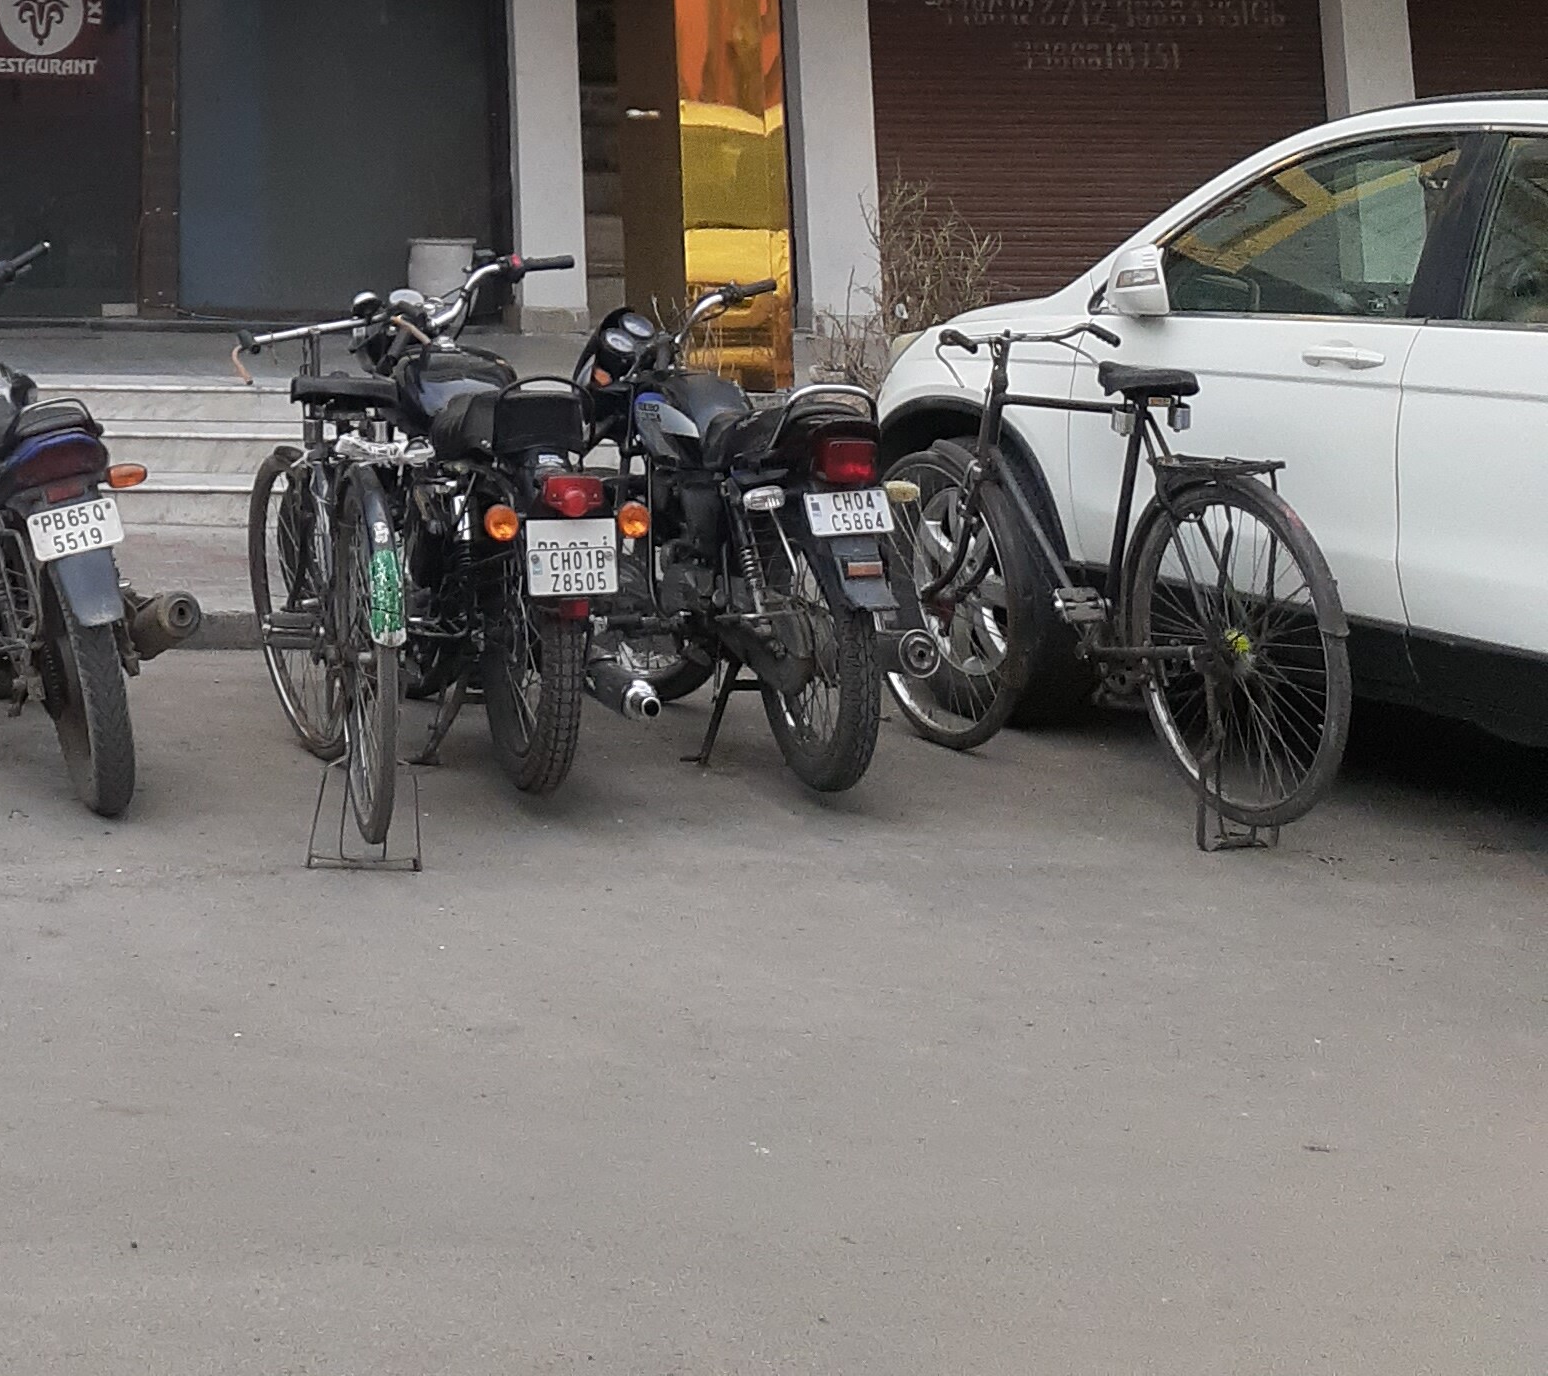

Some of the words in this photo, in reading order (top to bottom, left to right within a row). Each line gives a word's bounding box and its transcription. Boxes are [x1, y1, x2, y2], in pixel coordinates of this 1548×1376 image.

[87, 1, 102, 24] XI
[831, 511, 885, 532] C5864
[53, 527, 103, 554] 5519
[550, 549, 606, 571] CH01B
[550, 572, 607, 592] Z8505
